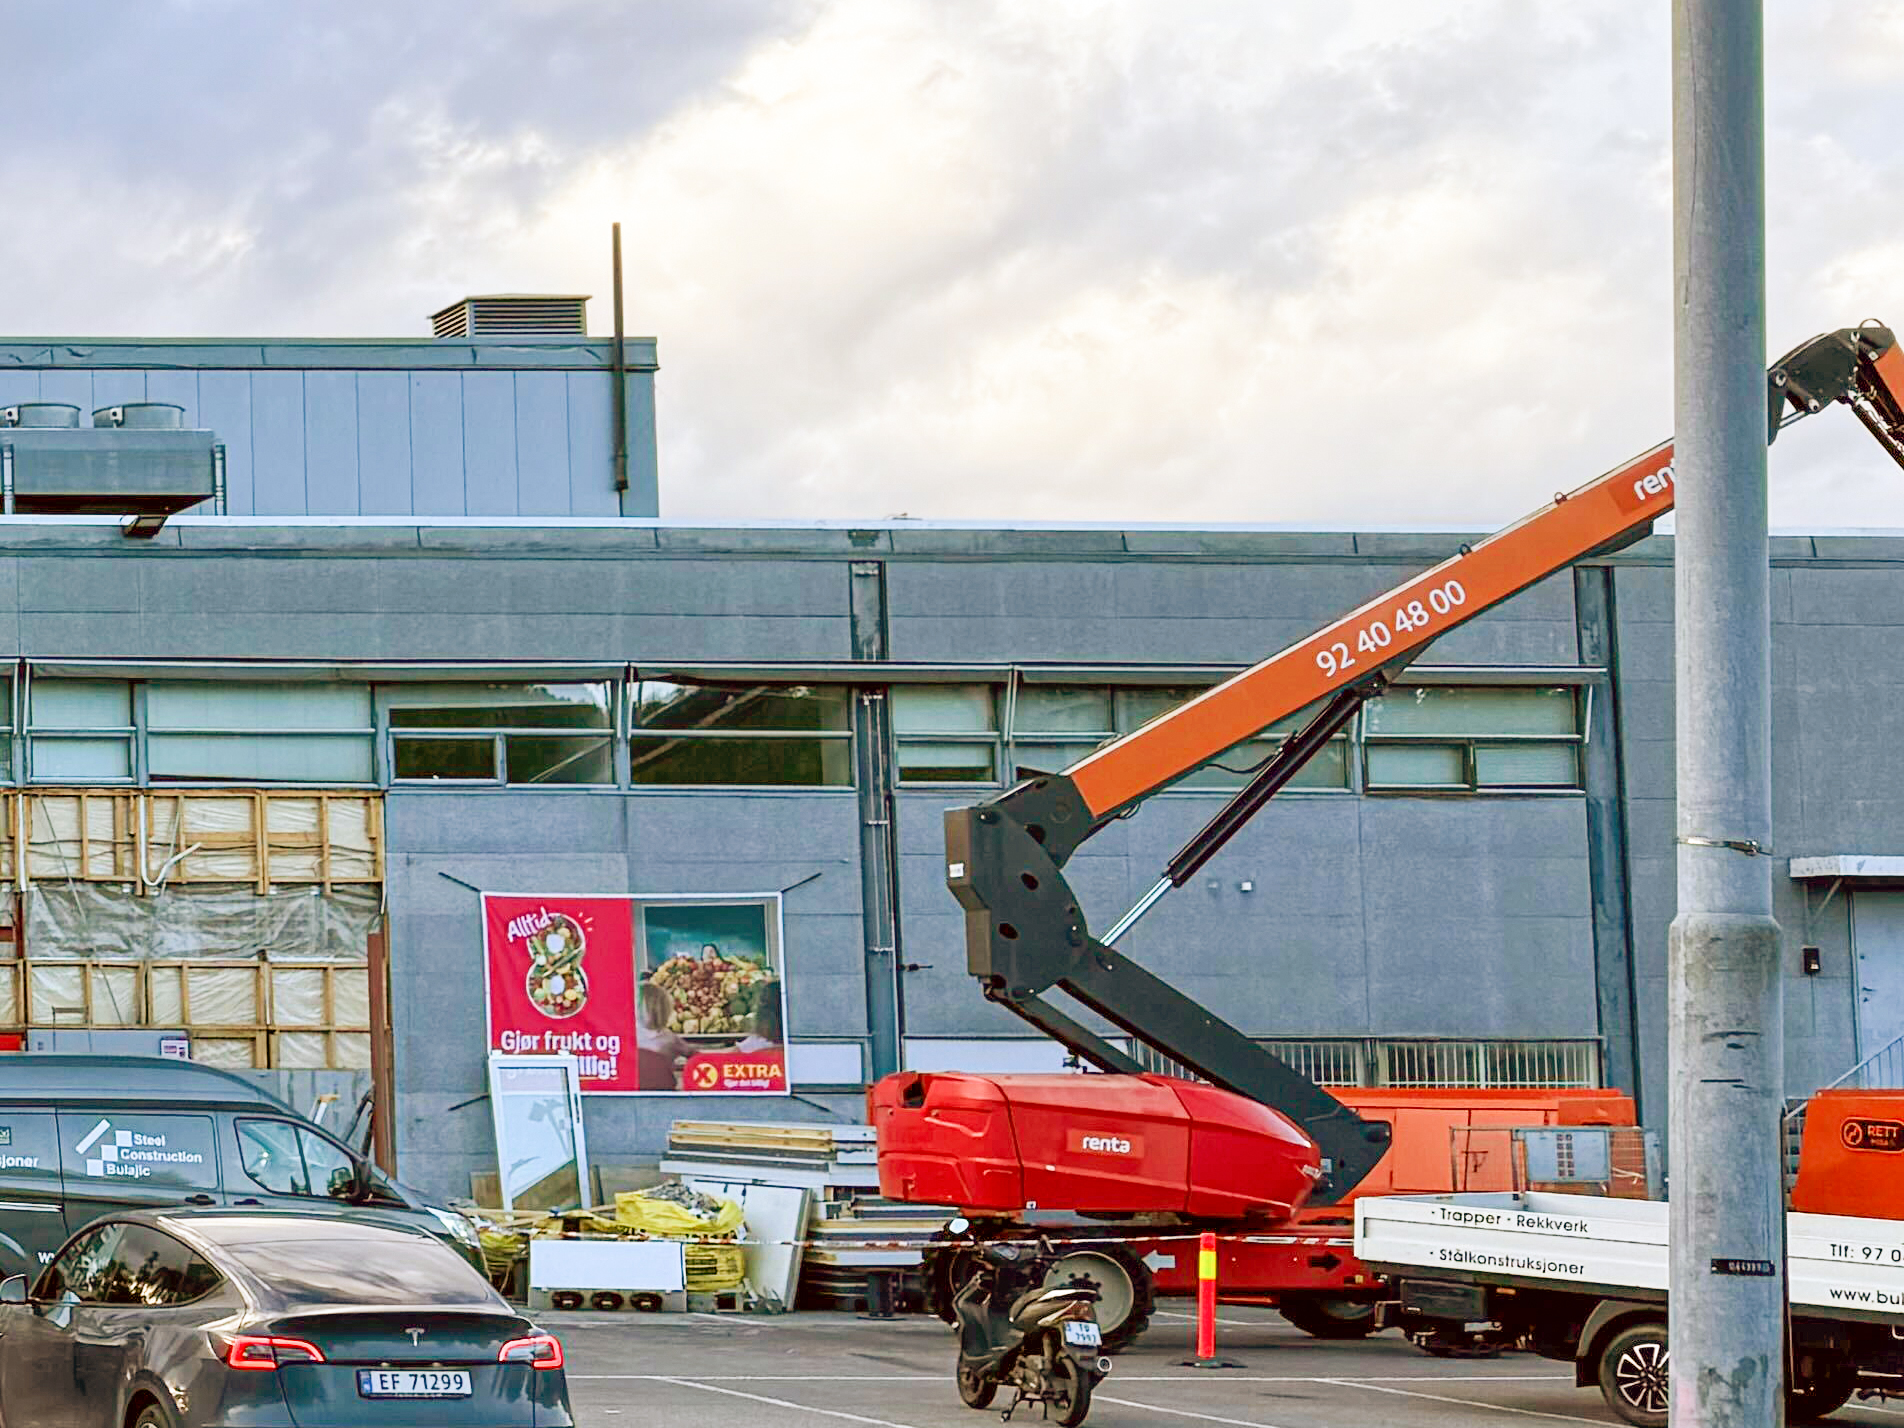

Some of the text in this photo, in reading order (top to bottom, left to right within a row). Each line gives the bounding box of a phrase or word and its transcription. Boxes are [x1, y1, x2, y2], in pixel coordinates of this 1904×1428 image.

[1634, 458, 1674, 501] ren
[1316, 580, 1466, 677] 92 40 48 00
[507, 906, 552, 943] Alltid
[501, 1030, 620, 1054] Gjør frukt og
[723, 1063, 783, 1078] EXTRA
[134, 1133, 166, 1147] Steel
[1082, 1136, 1131, 1154] renta
[120, 1149, 203, 1164] Construction
[1440, 1208, 1589, 1233] Trapper Rekkverk
[1439, 1248, 1585, 1275] Stålkonstruksjoner
[1830, 1243, 1904, 1262] Tlf: 97 0
[379, 1373, 464, 1390] EF 71299
